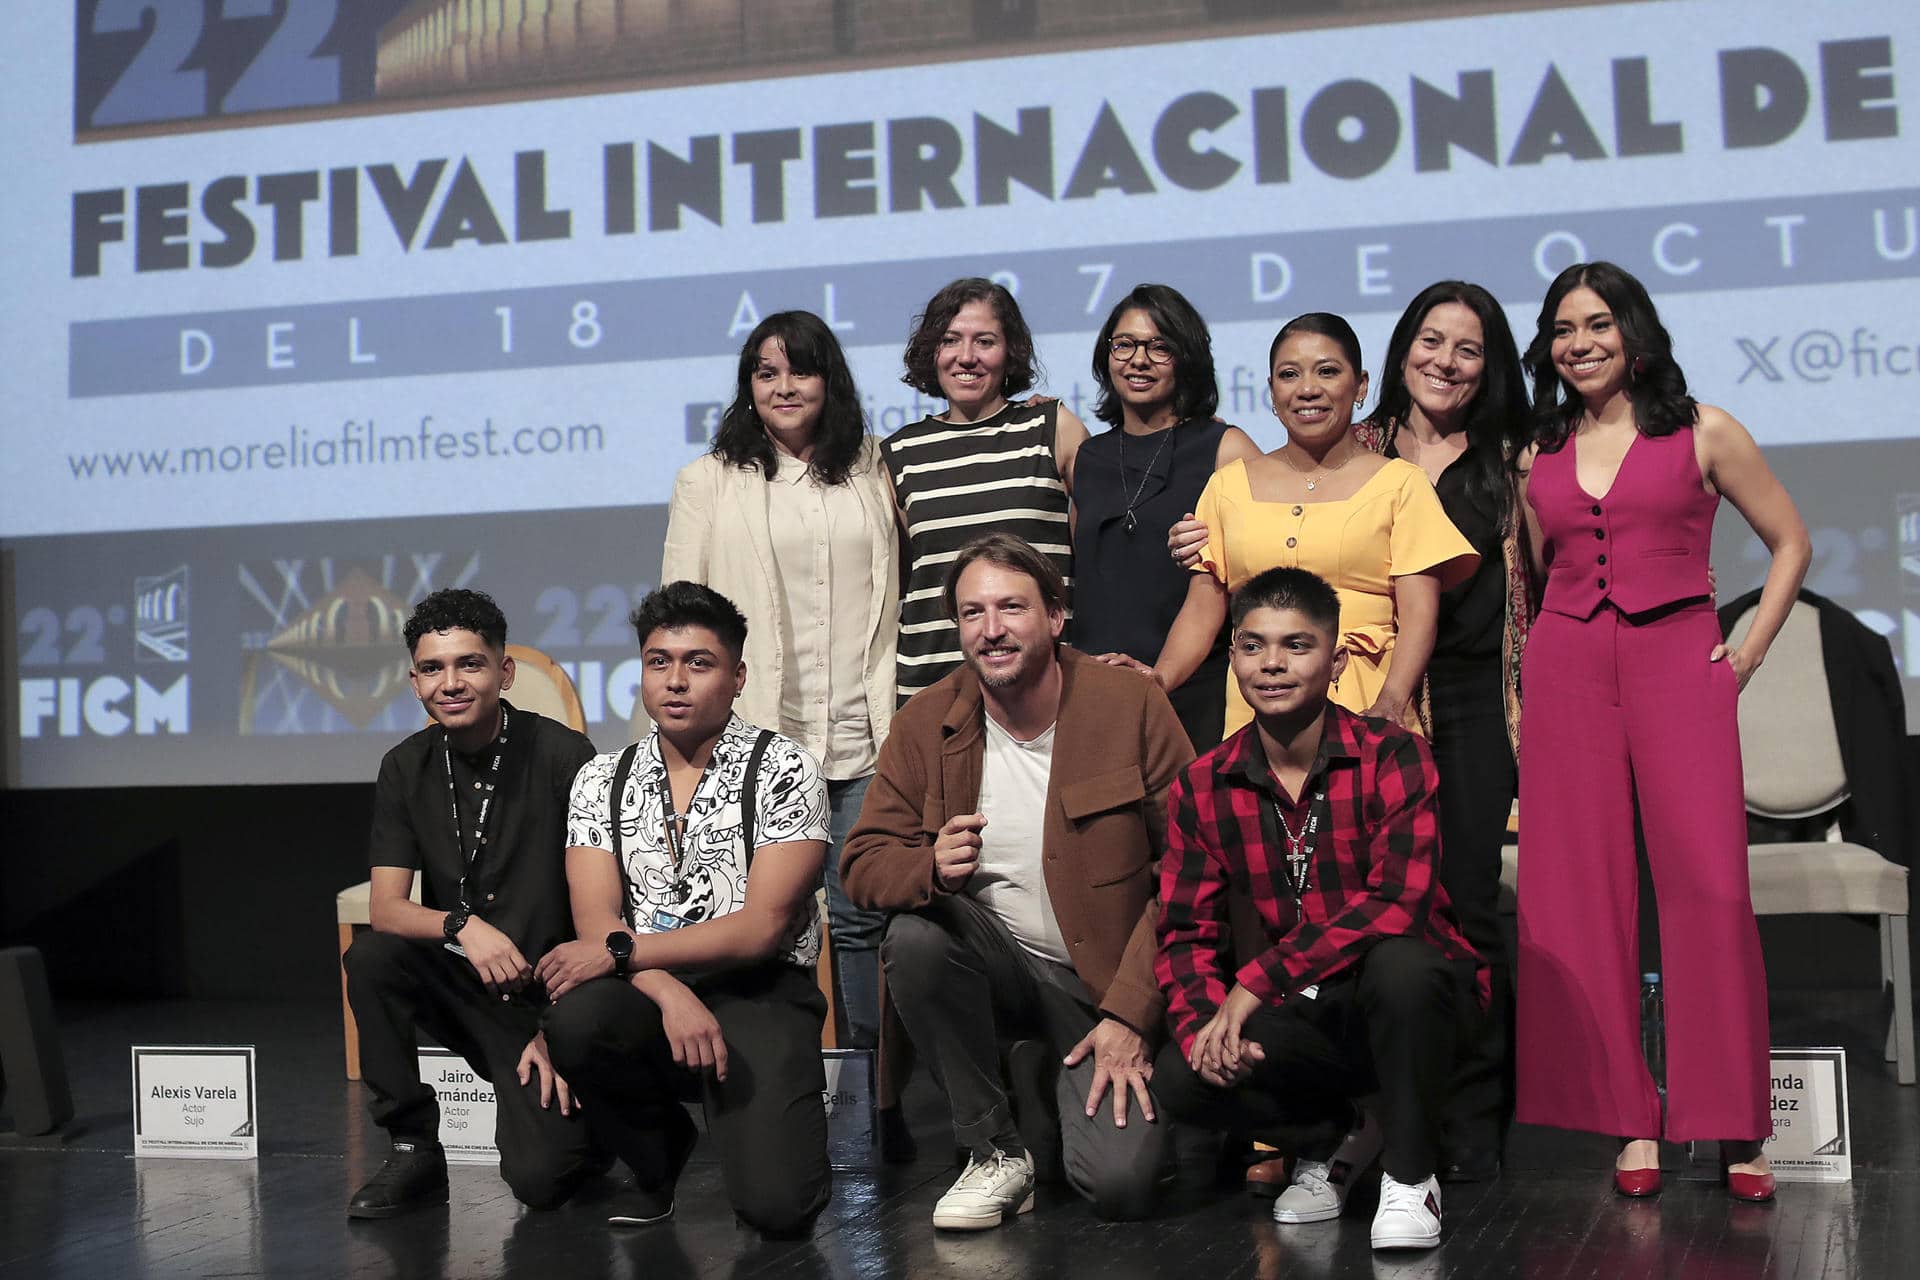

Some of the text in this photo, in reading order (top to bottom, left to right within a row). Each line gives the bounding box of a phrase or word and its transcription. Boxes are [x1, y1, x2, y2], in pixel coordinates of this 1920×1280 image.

[71, 36, 1900, 279] FESTIVAL INTERNACIONAL DE
[180, 317, 376, 375] DEL
[496, 301, 602, 350] 18
[728, 283, 855, 338] AL
[1251, 243, 1393, 302] DE
[1533, 207, 1920, 281] OCTU
[68, 415, 604, 480] www.moreliafilmfest.com
[19, 673, 190, 739] FICM
[438, 1070, 474, 1083] Jairo
[1771, 1074, 1804, 1090] nda
[151, 1085, 237, 1100] Alexis Varela
[182, 1103, 206, 1113] Actor
[444, 1106, 470, 1116] Actor
[184, 1115, 205, 1127] Sujo
[446, 1118, 468, 1131] Sujo
